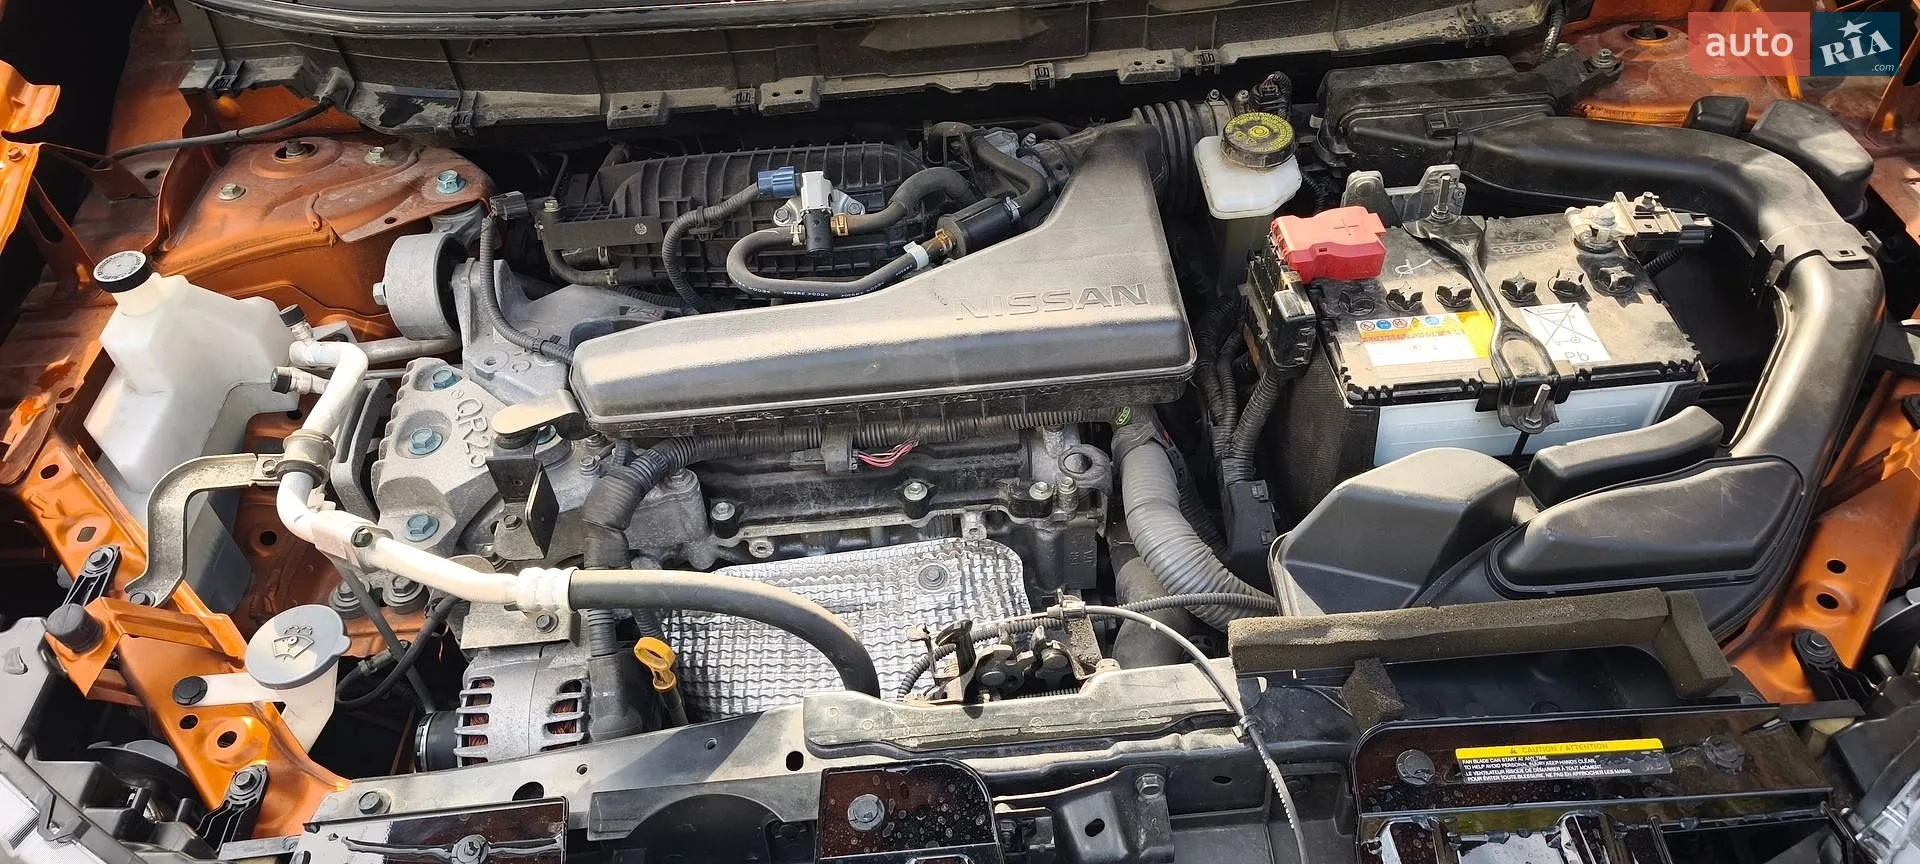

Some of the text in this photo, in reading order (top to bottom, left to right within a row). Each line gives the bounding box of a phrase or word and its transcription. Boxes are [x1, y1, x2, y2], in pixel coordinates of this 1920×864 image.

[954, 283, 1150, 321] NISSAN
[1564, 351, 1590, 362] Pb
[1522, 745, 1557, 754] CAUTION
[1565, 742, 1609, 752] ATTENTION
